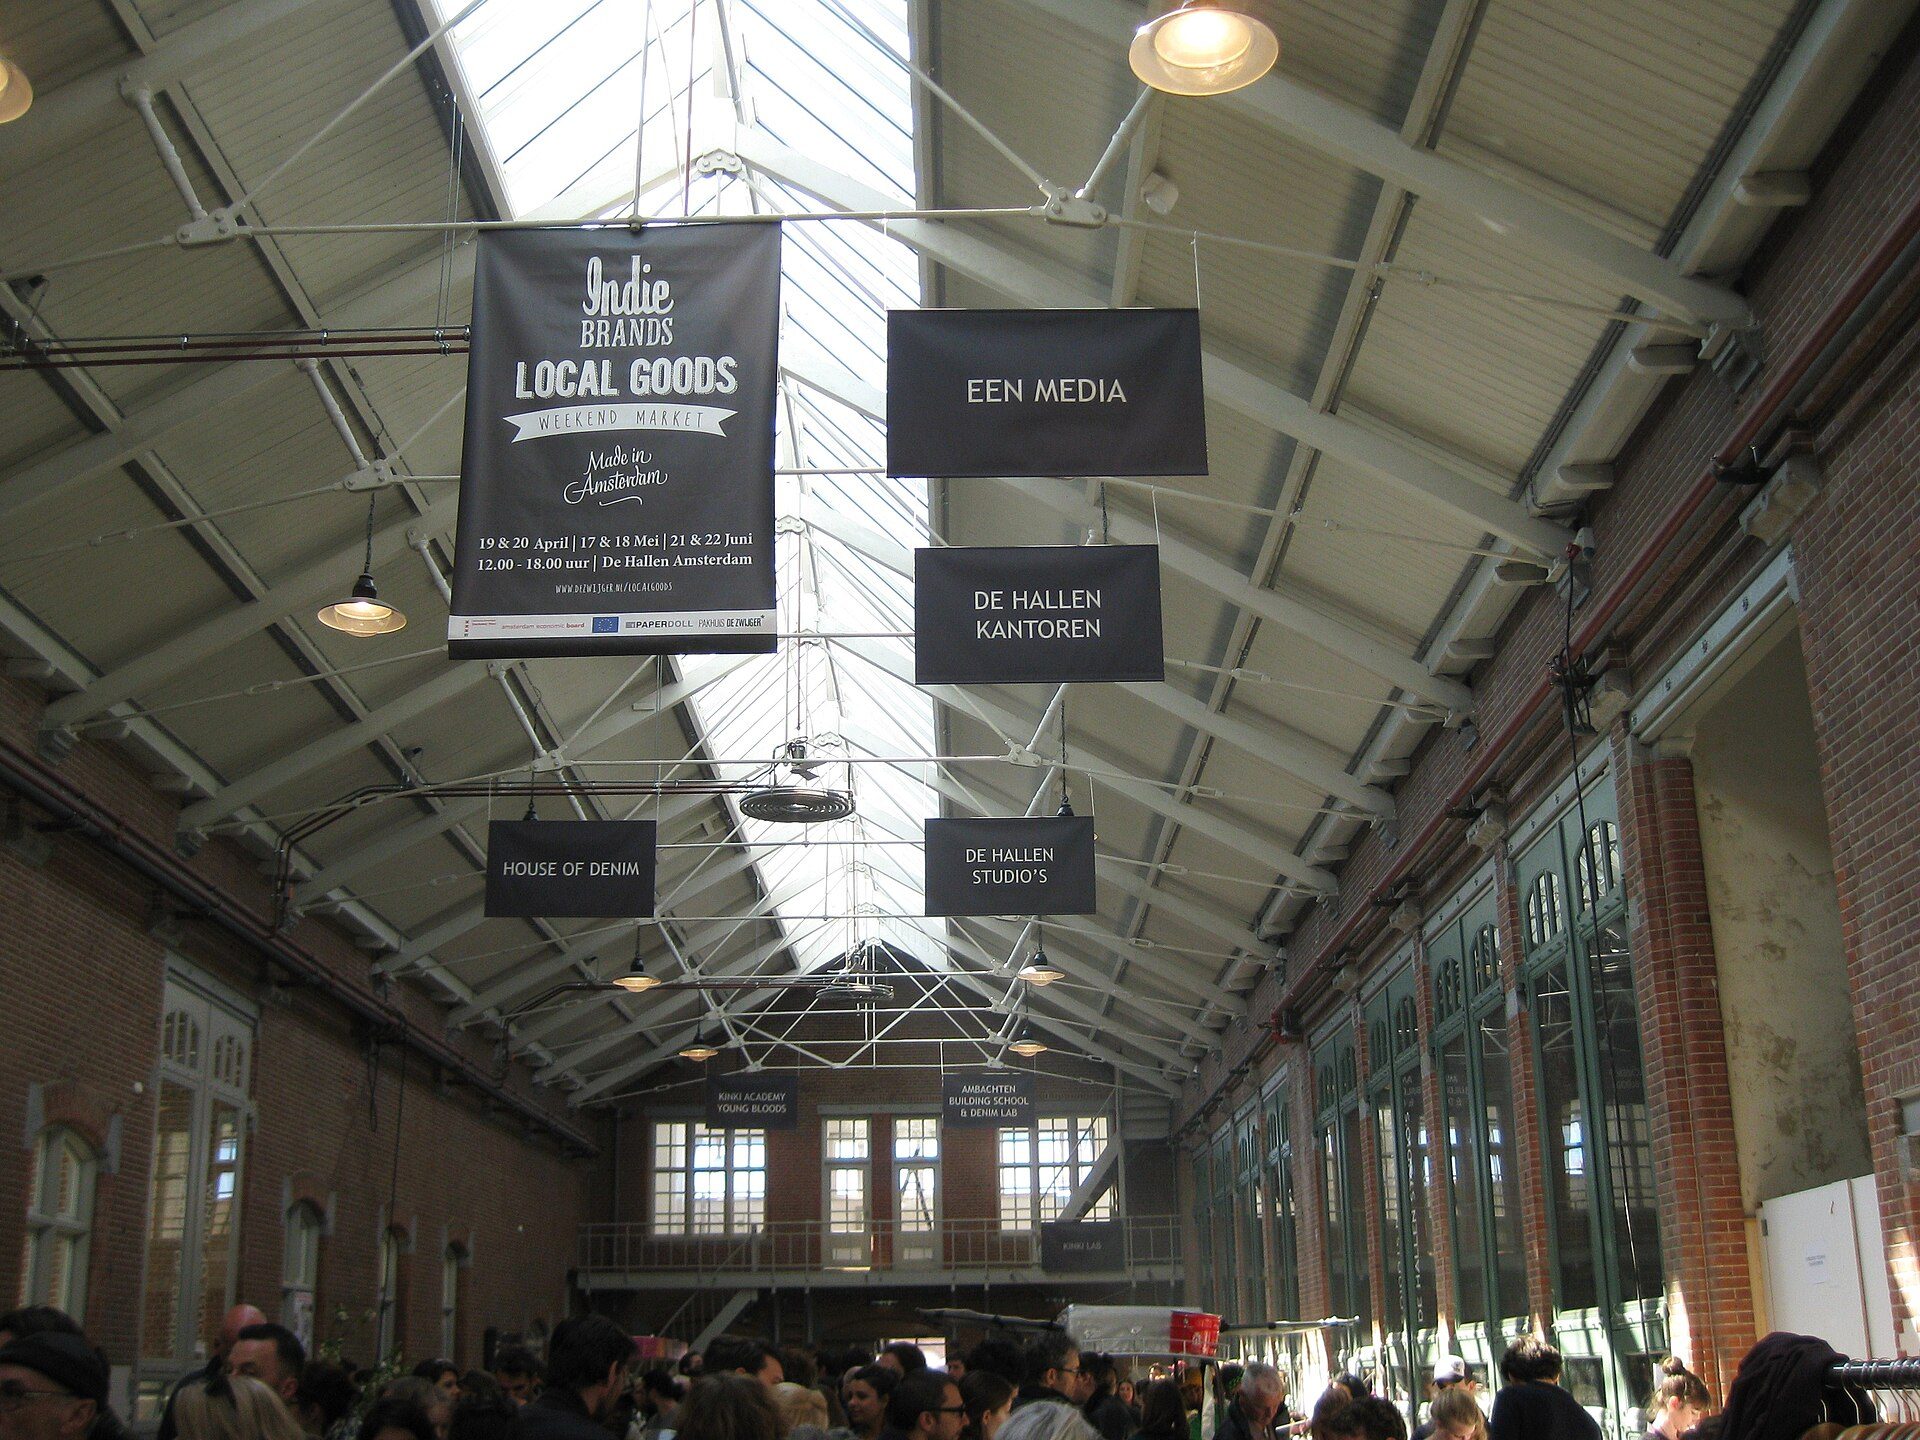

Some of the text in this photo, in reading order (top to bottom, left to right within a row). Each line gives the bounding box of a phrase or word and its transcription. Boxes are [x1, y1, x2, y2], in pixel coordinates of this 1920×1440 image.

[582, 255, 675, 317] Indie
[580, 317, 674, 348] BRANDS
[515, 356, 738, 399] LOCAL GOODS
[967, 378, 1127, 403] EEN MEDIA
[538, 410, 704, 431] WEEKEND MARKET
[583, 445, 652, 476] Made in
[563, 465, 668, 504] Amsterdam
[480, 537, 495, 550] 19
[498, 537, 510, 549] &
[513, 536, 529, 549] 20
[533, 536, 569, 552] April
[581, 536, 596, 549] 17
[600, 535, 612, 548] &
[615, 535, 630, 548] 18
[634, 535, 659, 547] Mei
[670, 534, 685, 547] 21
[690, 533, 702, 546] &
[705, 533, 721, 546] 22
[724, 533, 753, 547] Juni
[478, 558, 514, 571] 12.00
[526, 557, 562, 570] 18.00
[565, 559, 590, 569] uur
[603, 556, 621, 568] De
[625, 555, 669, 568] Hallen
[672, 553, 753, 567] Amsterdam
[974, 589, 1102, 610] DE HALLEN
[566, 621, 585, 629] board
[636, 620, 694, 629] PAPERDOLL
[976, 618, 1101, 639] KANTOREN
[966, 847, 1054, 863] DE HALLEN
[503, 862, 640, 876] HOUSE OF DENIM
[972, 869, 1048, 884] STUDIO'S
[718, 1092, 787, 1101] KINKI ACADEMY
[961, 1085, 1016, 1094] AMBACHTEN
[717, 1104, 787, 1113] YOUNG BLOODS
[949, 1096, 1029, 1106] BUILDING SCHOOL
[960, 1108, 1018, 1117] & DENIM LAB
